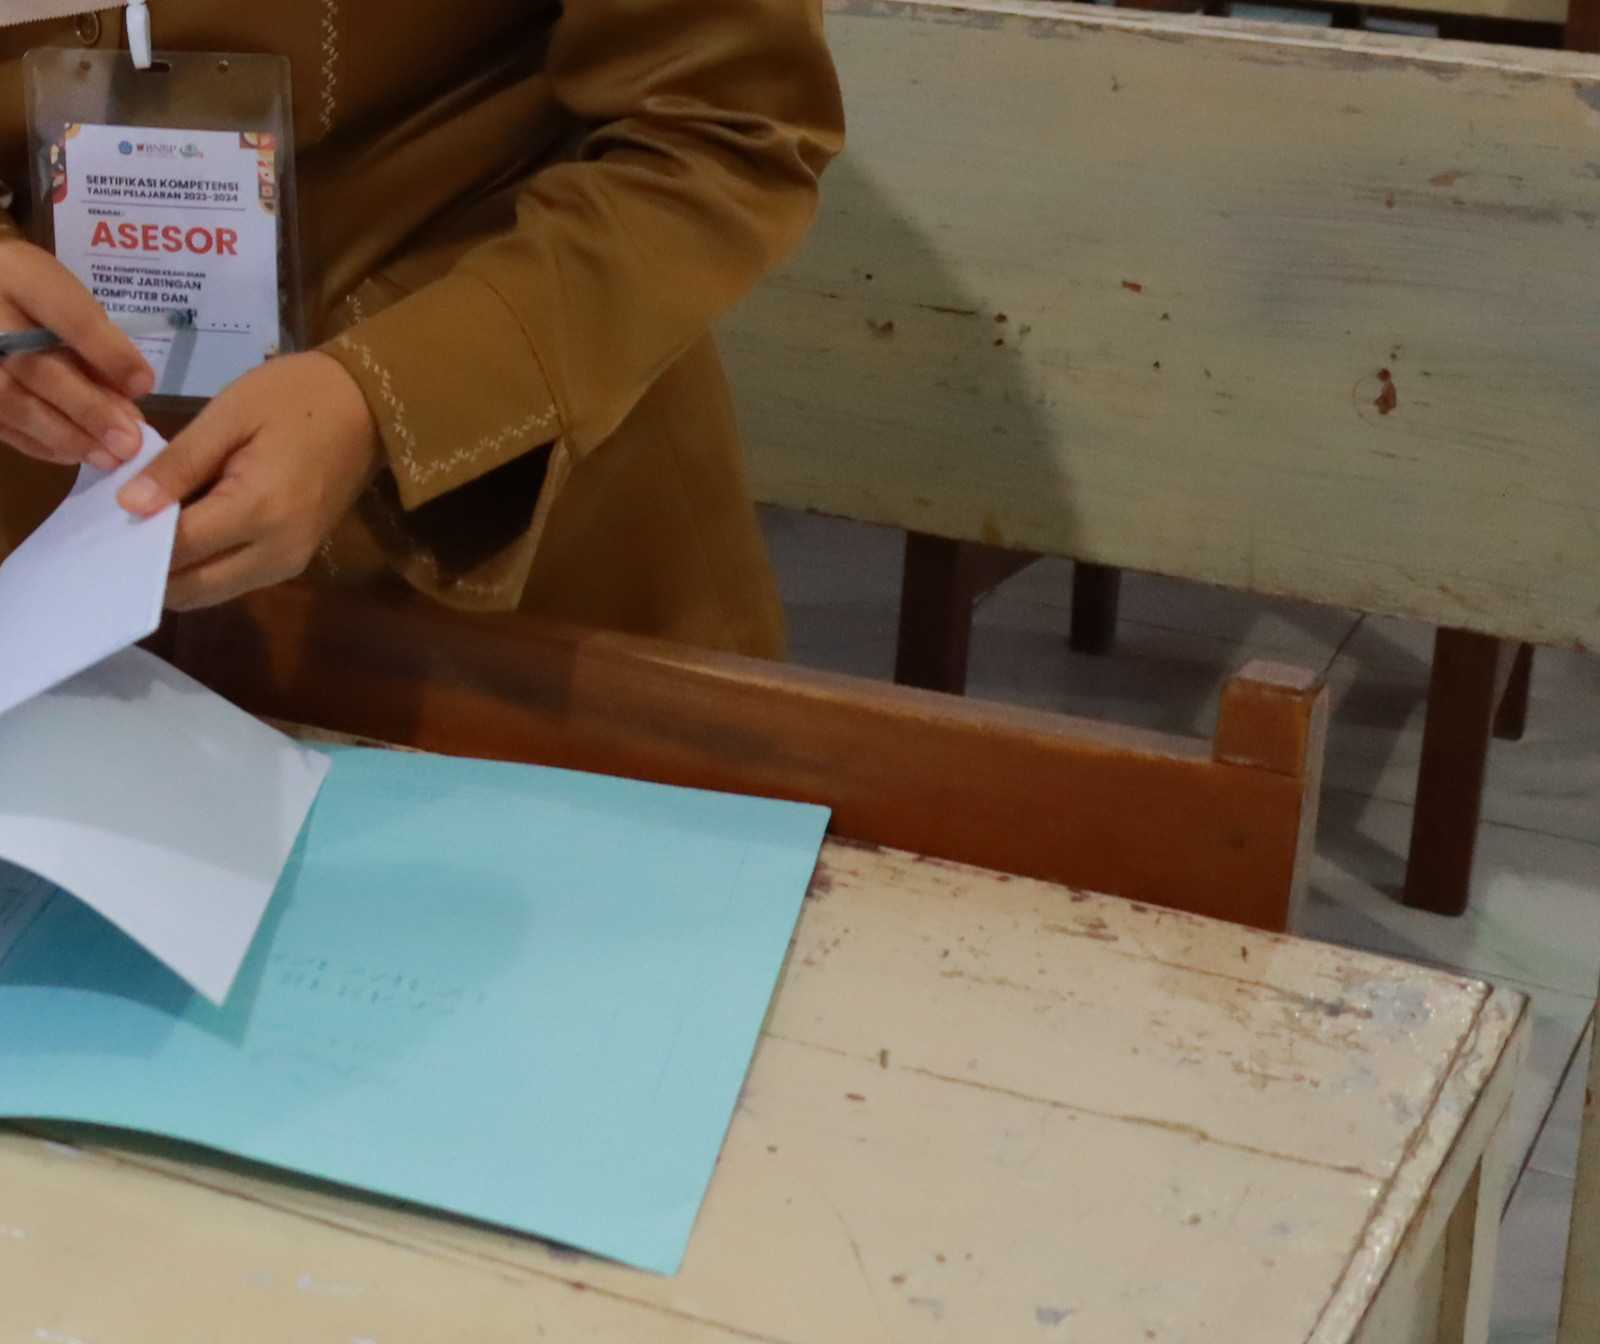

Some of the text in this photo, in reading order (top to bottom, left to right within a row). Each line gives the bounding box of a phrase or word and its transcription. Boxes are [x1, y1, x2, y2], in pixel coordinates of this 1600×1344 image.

[86, 174, 239, 192] SERTIFIKASI KOMPETENSI
[87, 187, 121, 197] TAHUN
[123, 189, 181, 201] PELAJARAN
[90, 221, 238, 256] ASESOR
[92, 272, 201, 292] TEKNIK JARINGAN
[92, 287, 188, 305] KOMPUTER DAN
